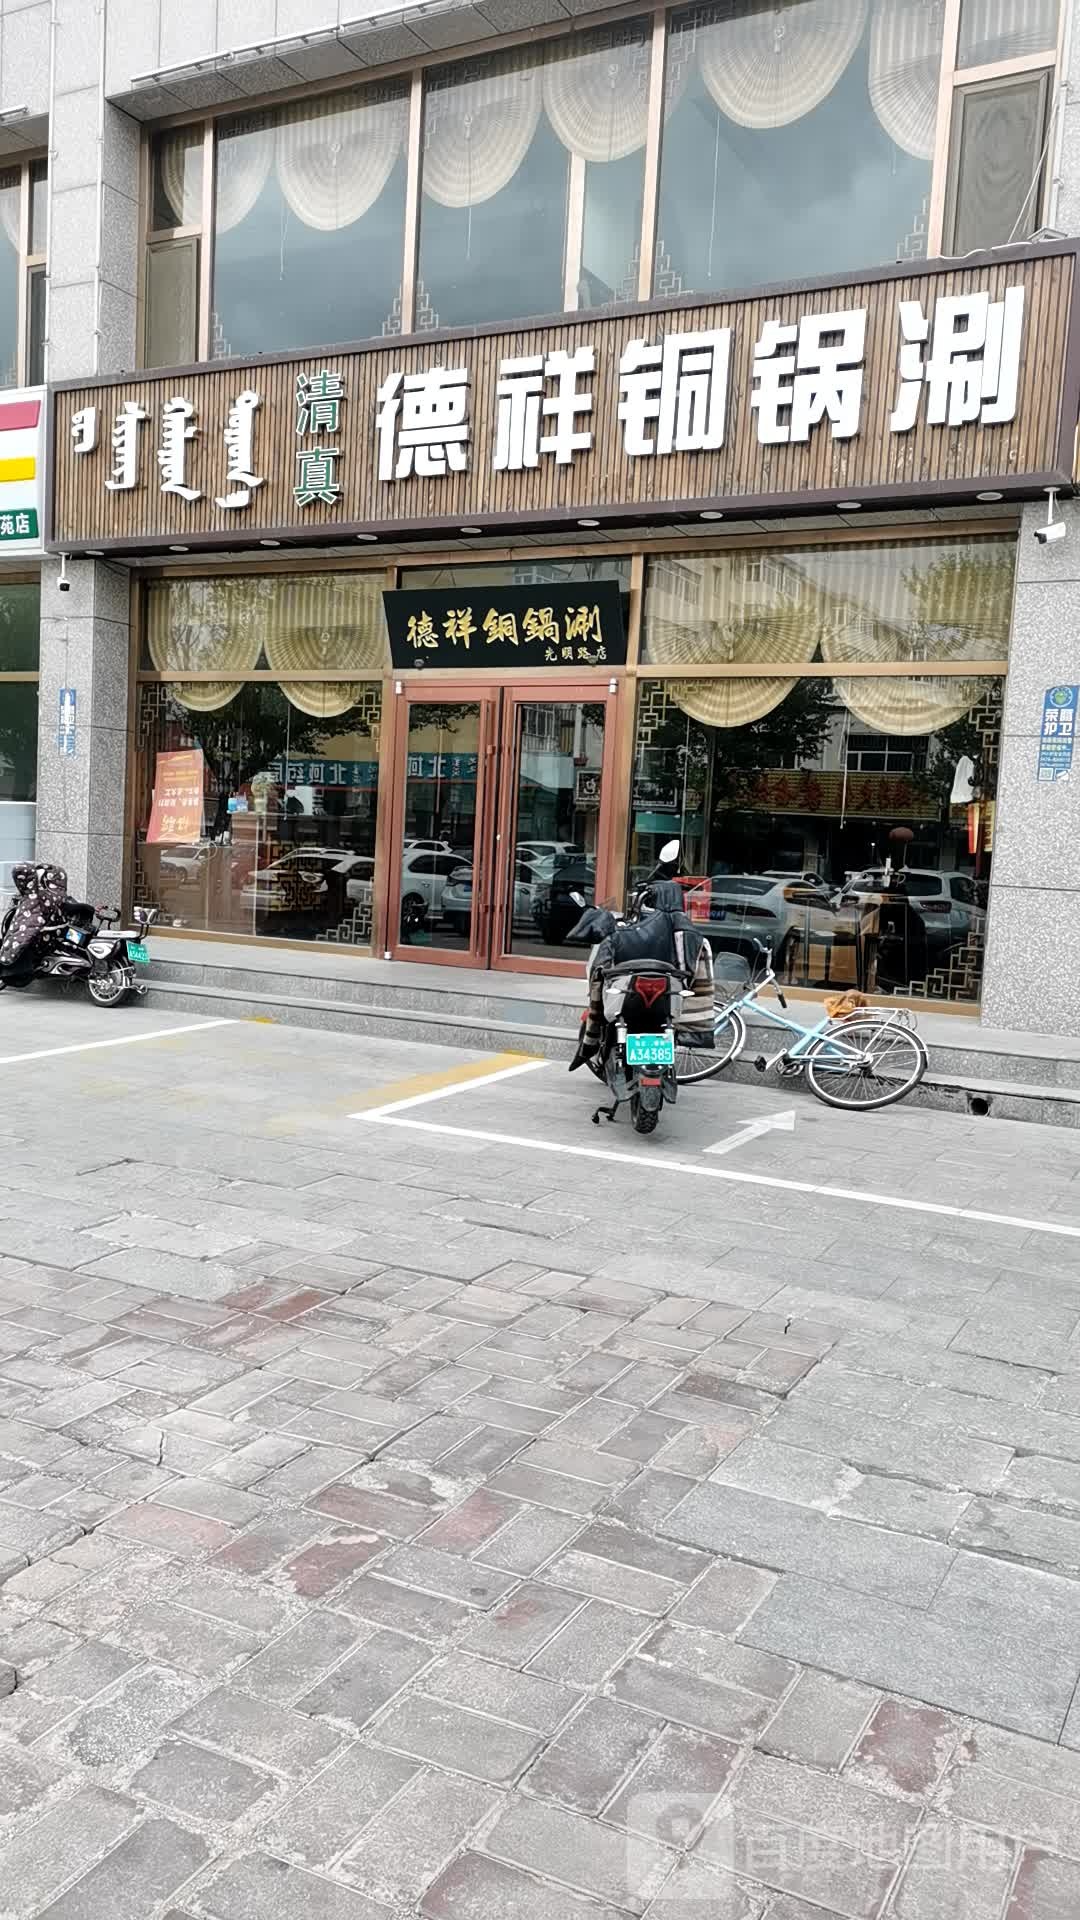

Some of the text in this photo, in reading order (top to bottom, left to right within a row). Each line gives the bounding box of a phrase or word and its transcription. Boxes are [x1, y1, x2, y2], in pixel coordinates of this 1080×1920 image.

[376, 285, 1026, 481] 德祥铜锅涮
[293, 369, 344, 508] 清真
[0, 512, 30, 535] 苑店
[1043, 722, 1074, 737] 护卫
[629, 1048, 672, 1062] A34385
